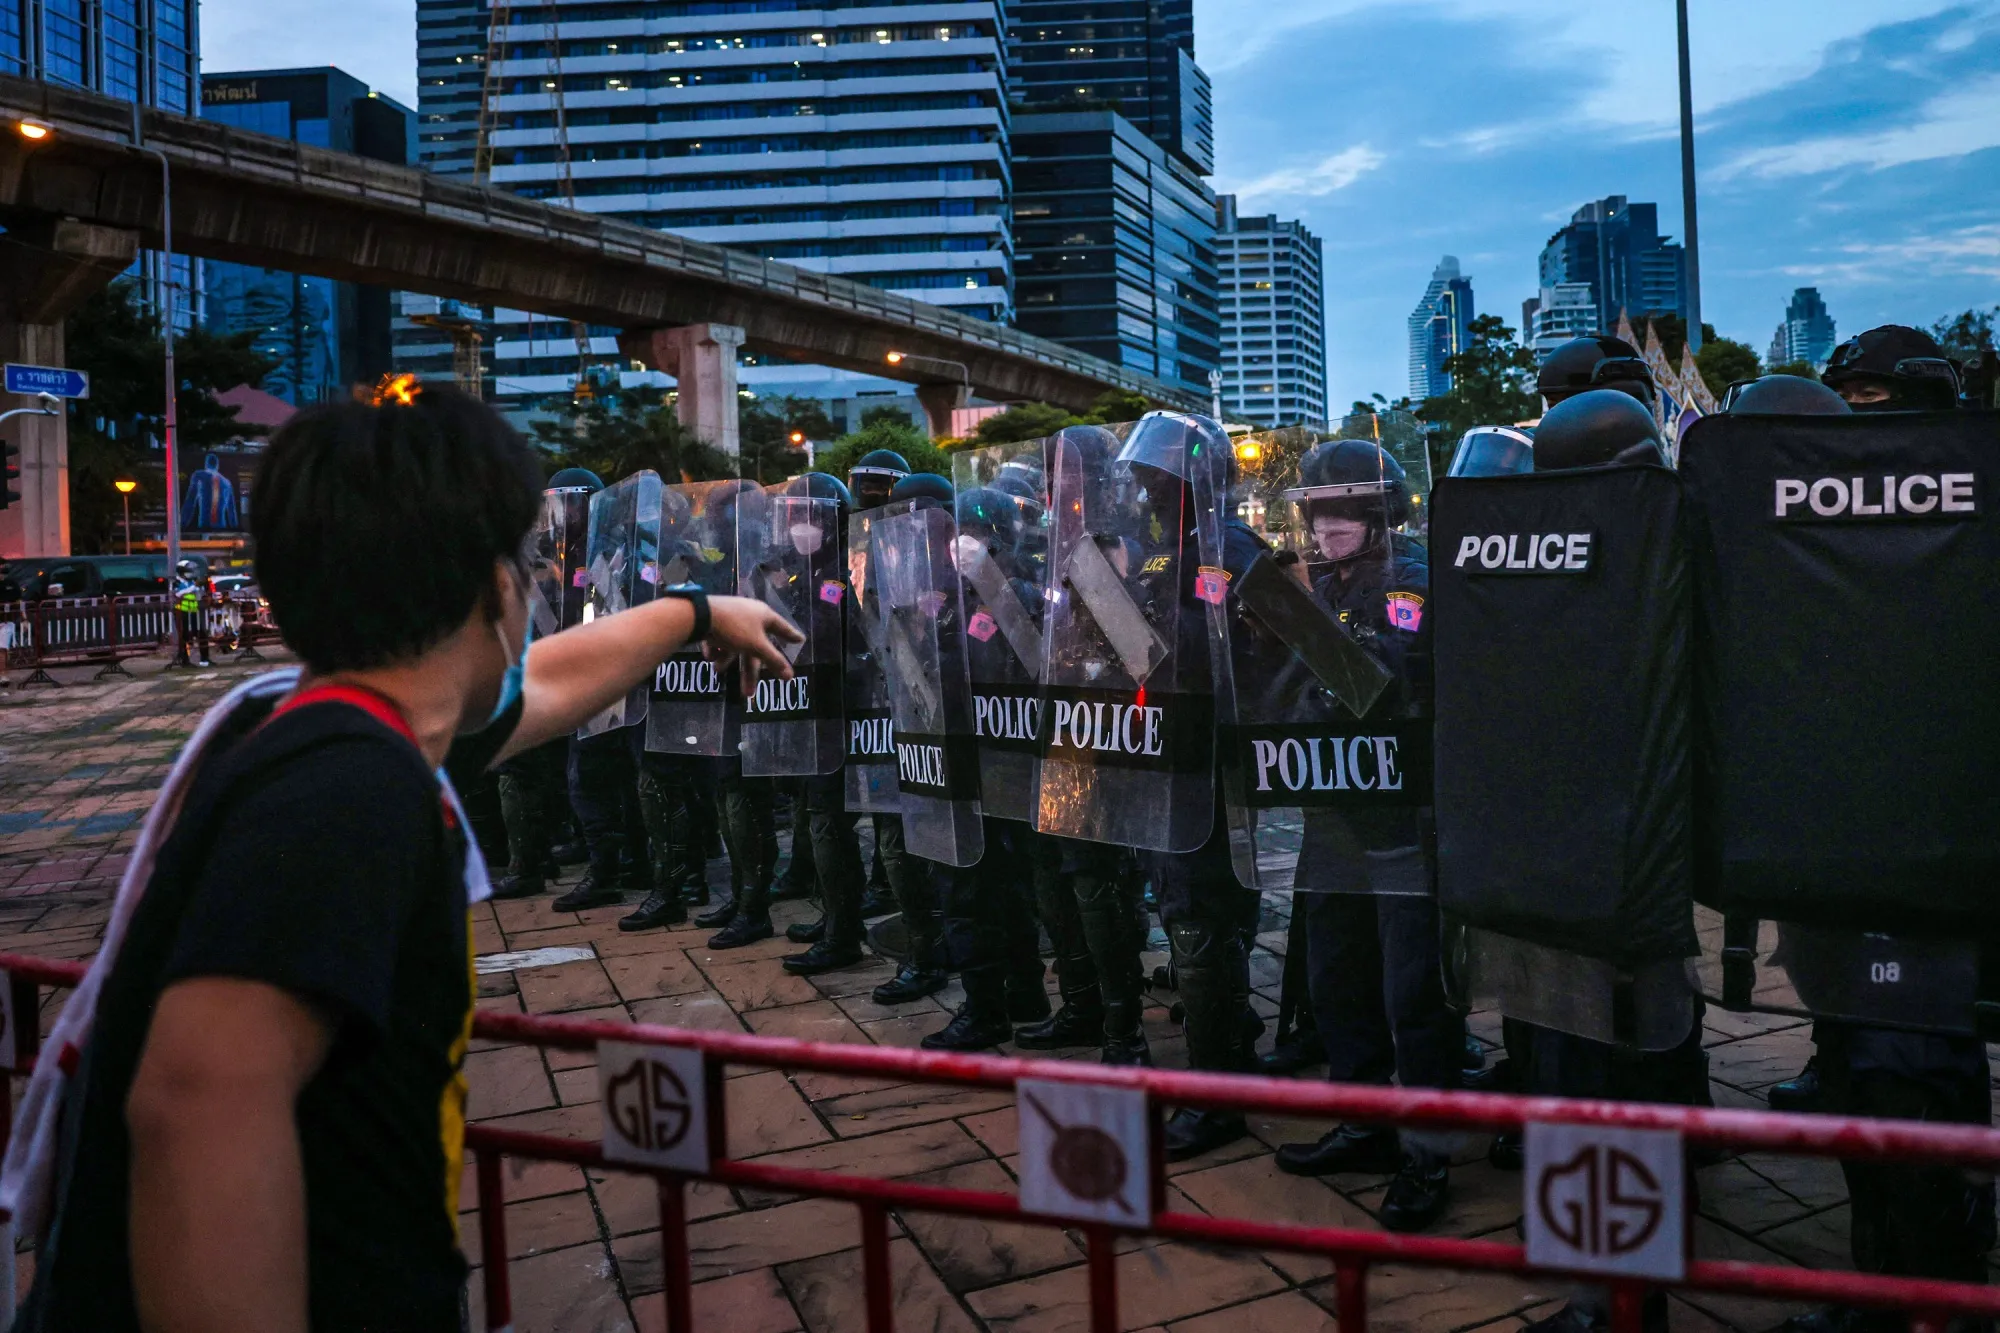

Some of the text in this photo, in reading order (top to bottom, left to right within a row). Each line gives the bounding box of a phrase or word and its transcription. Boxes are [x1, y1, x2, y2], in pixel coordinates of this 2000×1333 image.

[1775, 473, 1975, 517] POLICE
[1454, 533, 1591, 570] POLICE
[654, 660, 721, 693] POLICE
[850, 718, 896, 755] POLIC
[973, 695, 1039, 741] POLIC
[1052, 700, 1163, 756] POLICE
[897, 743, 946, 787] POLICE
[1251, 735, 1403, 791] POLICE
